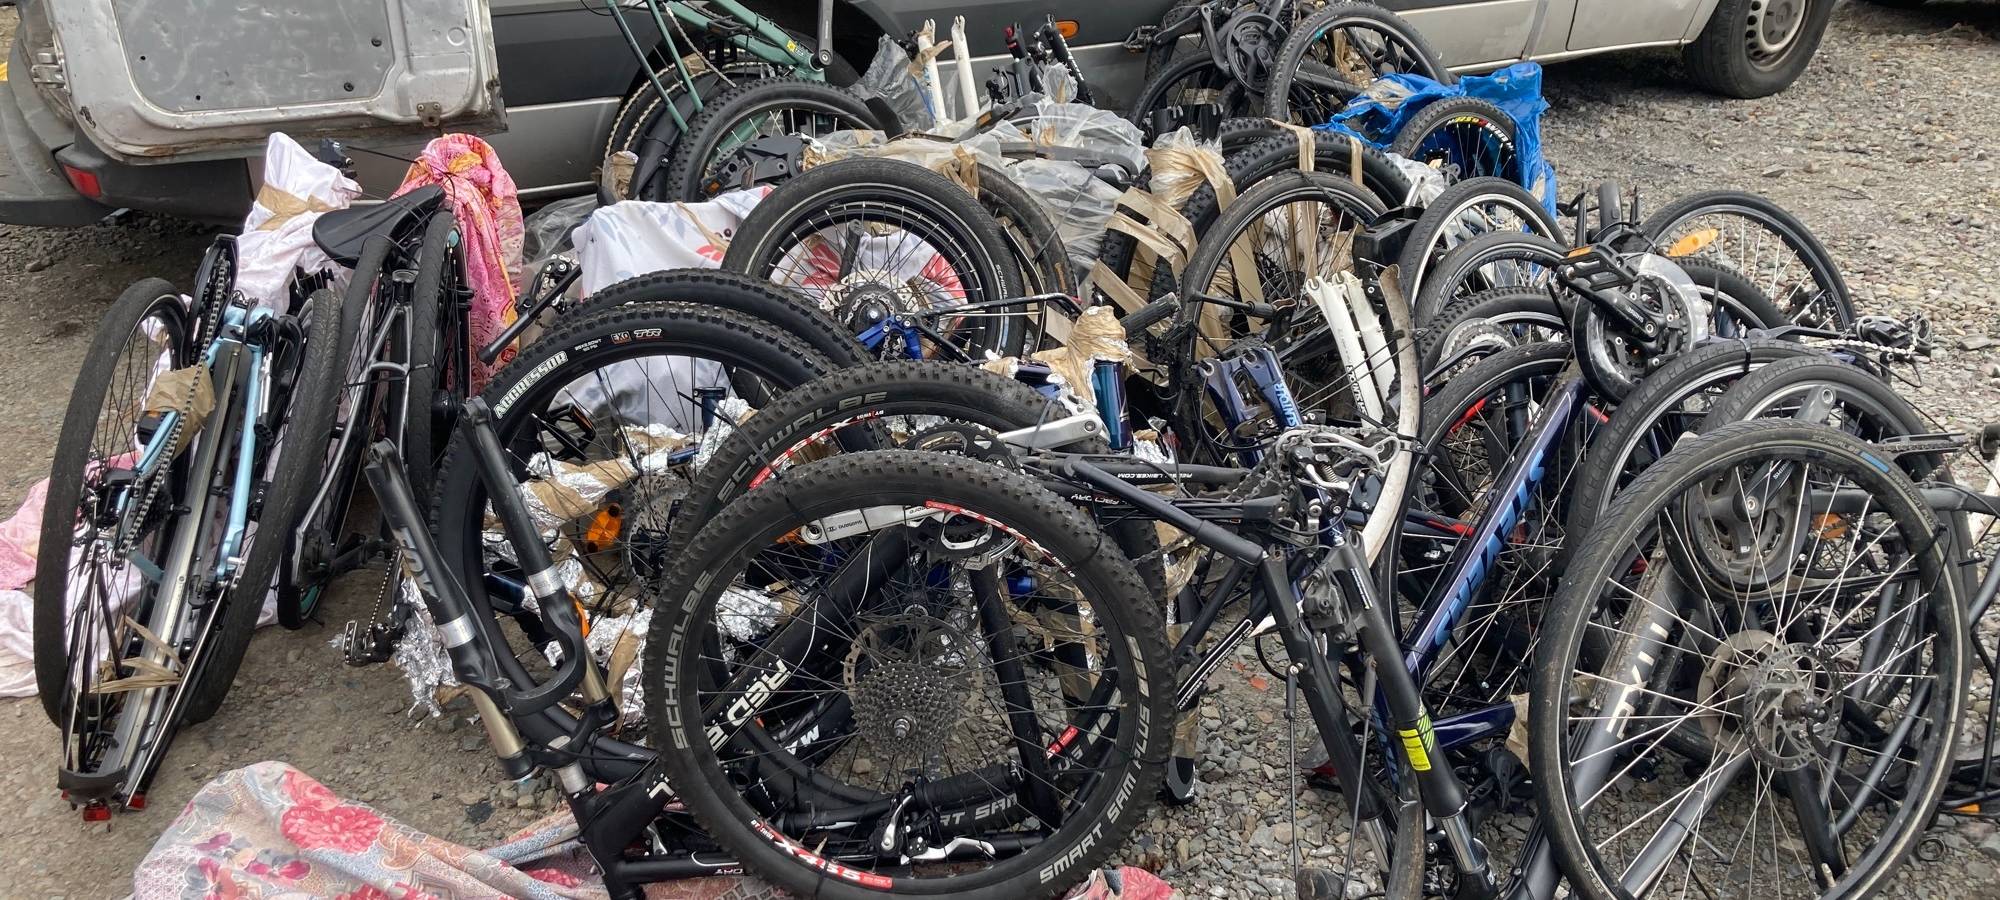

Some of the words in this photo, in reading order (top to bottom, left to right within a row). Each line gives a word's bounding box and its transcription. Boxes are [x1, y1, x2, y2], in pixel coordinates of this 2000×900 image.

[611, 331, 632, 344] EXO
[634, 328, 662, 338] TR
[493, 350, 569, 420] AGGRESSOR
[717, 391, 888, 503] SCHWALBE
[392, 526, 441, 602] FOX
[1435, 449, 1545, 646] STEVENS
[664, 570, 712, 749] SCHWALBE
[727, 659, 791, 727] RED
[1040, 823, 1103, 884] SMART
[1107, 772, 1137, 824] SAM
